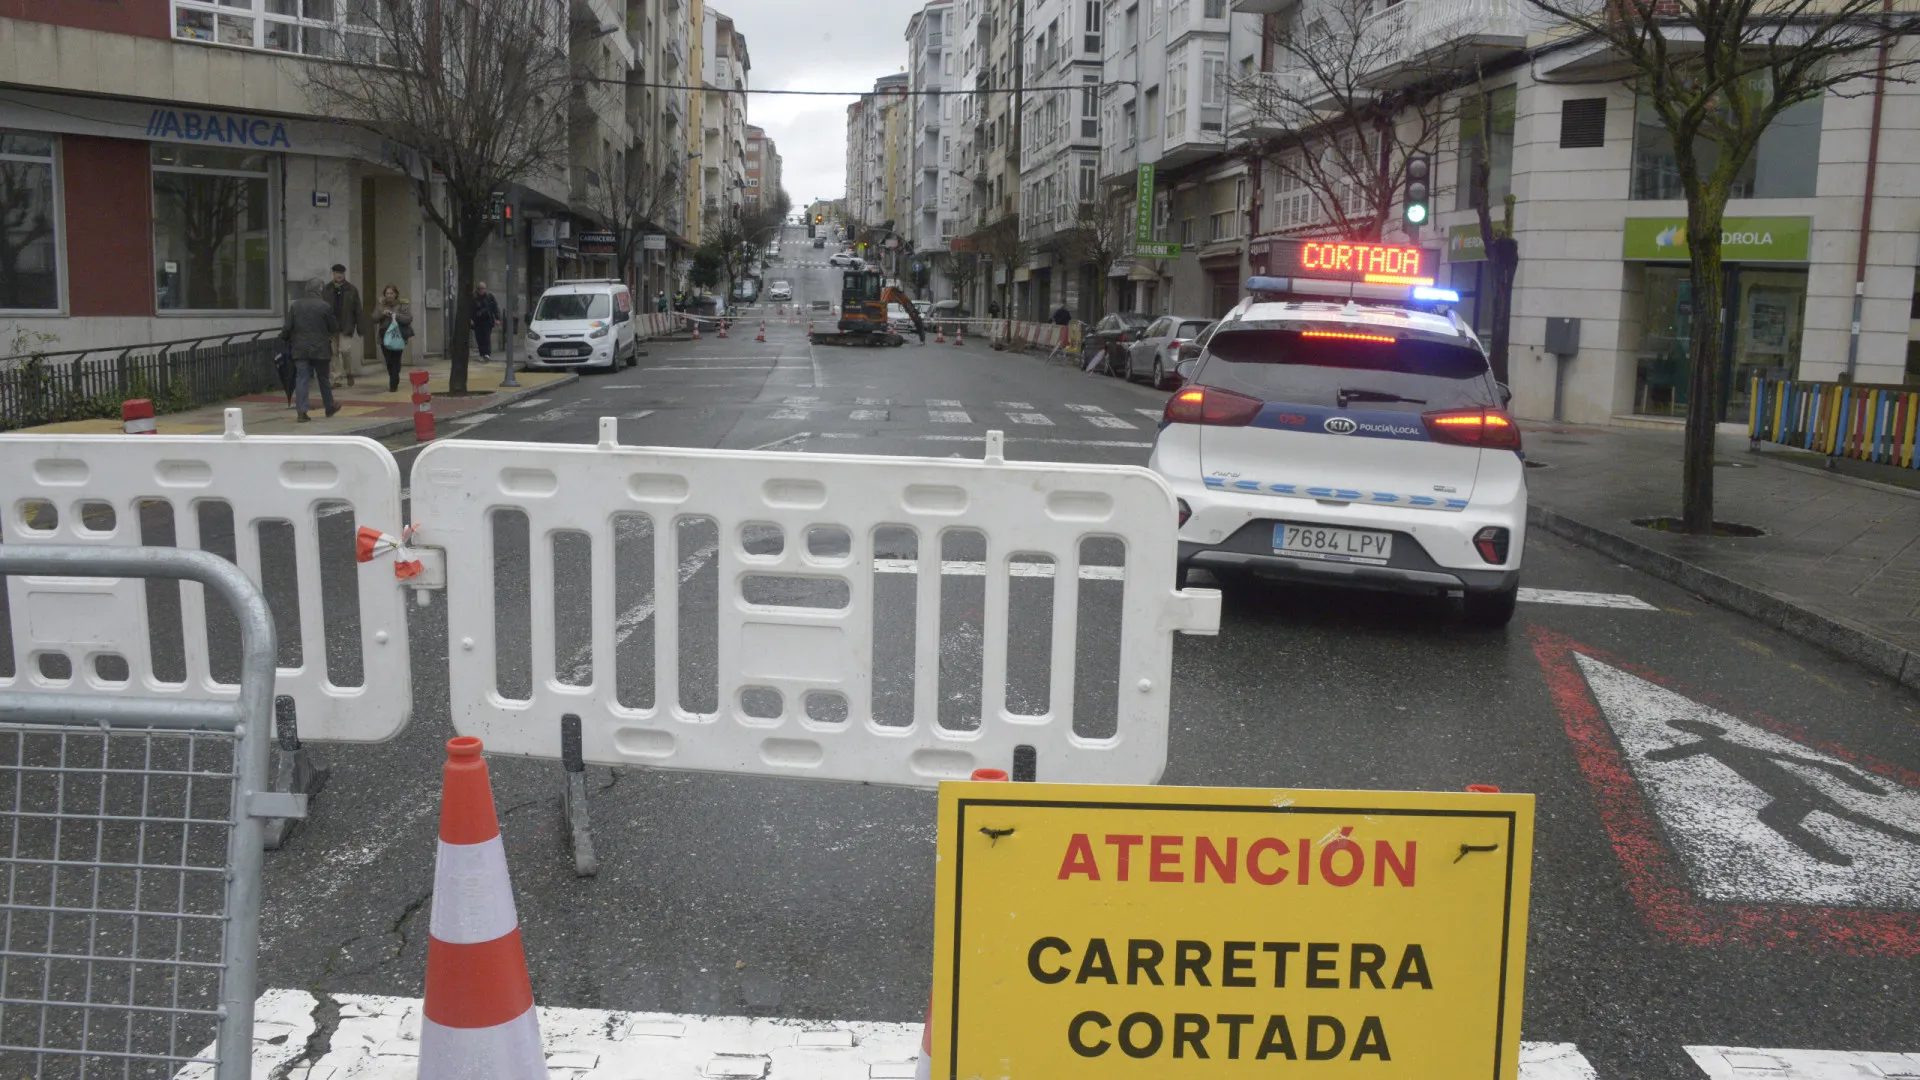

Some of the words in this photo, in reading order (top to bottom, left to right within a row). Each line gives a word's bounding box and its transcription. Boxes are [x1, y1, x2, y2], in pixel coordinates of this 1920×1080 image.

[1721, 231, 1773, 246] DROLA
[1302, 242, 1421, 274] CORTADA
[1394, 426, 1420, 435] LOCAL
[1287, 528, 1339, 550] 7684
[1347, 533, 1387, 555] LPV
[1058, 827, 1417, 888] ATENCIÓN
[1027, 936, 1433, 990] CARRETERA
[1067, 1010, 1392, 1061] CORTADA
